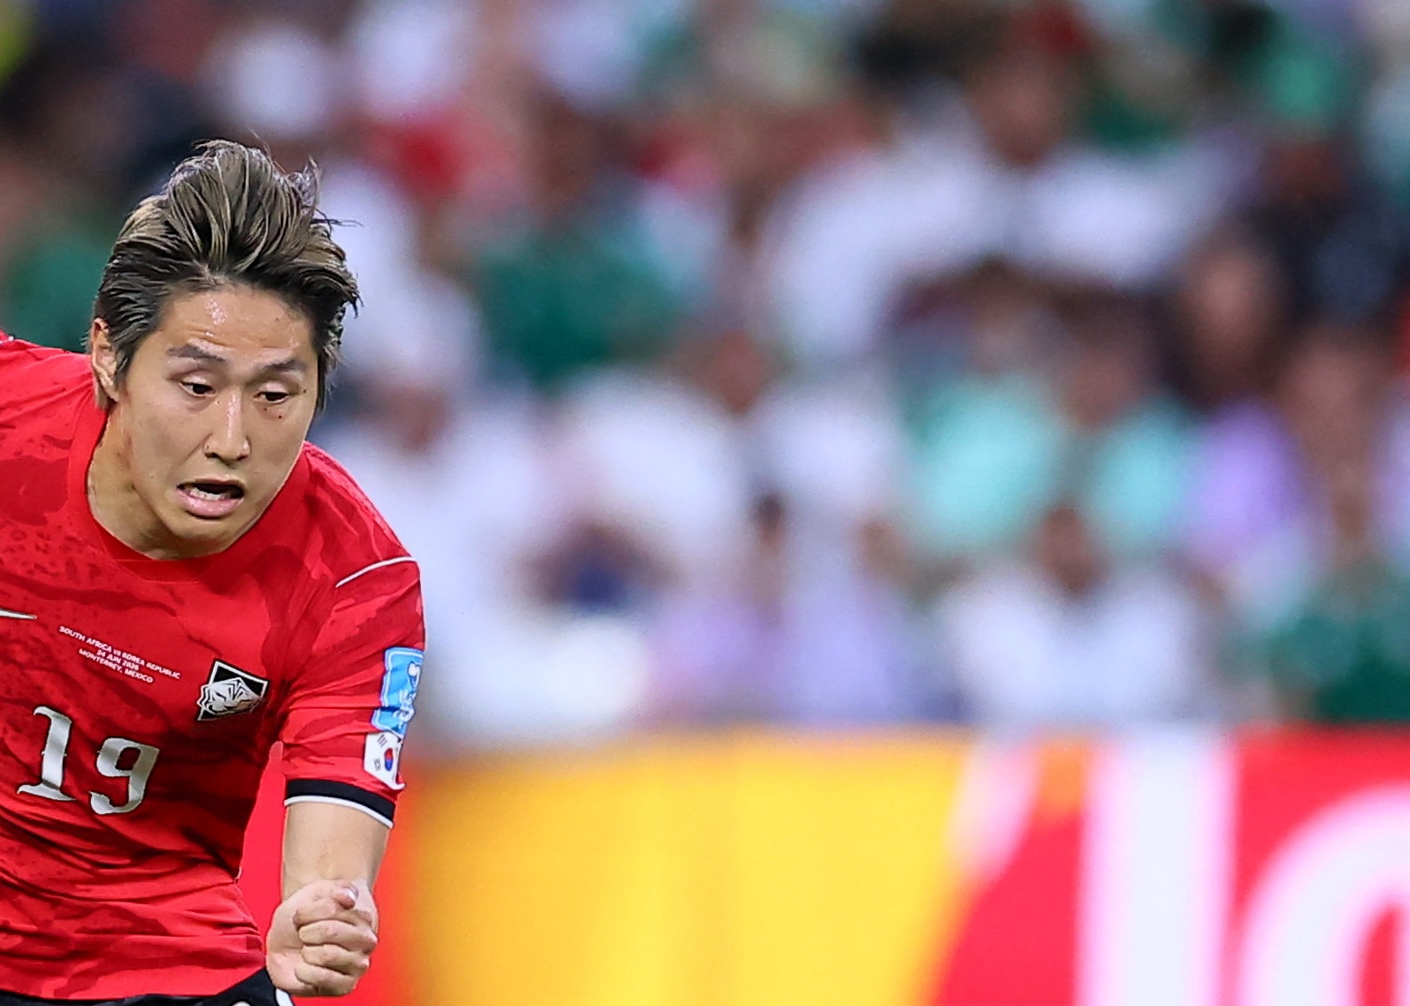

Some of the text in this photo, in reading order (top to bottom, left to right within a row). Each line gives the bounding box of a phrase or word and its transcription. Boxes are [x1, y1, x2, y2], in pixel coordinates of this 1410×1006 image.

[59, 625, 86, 642] SOUTH
[86, 637, 112, 652] AFRICA
[122, 652, 145, 666] KOREA
[146, 661, 181, 680] REPUBLIC
[16, 705, 160, 815] 19
